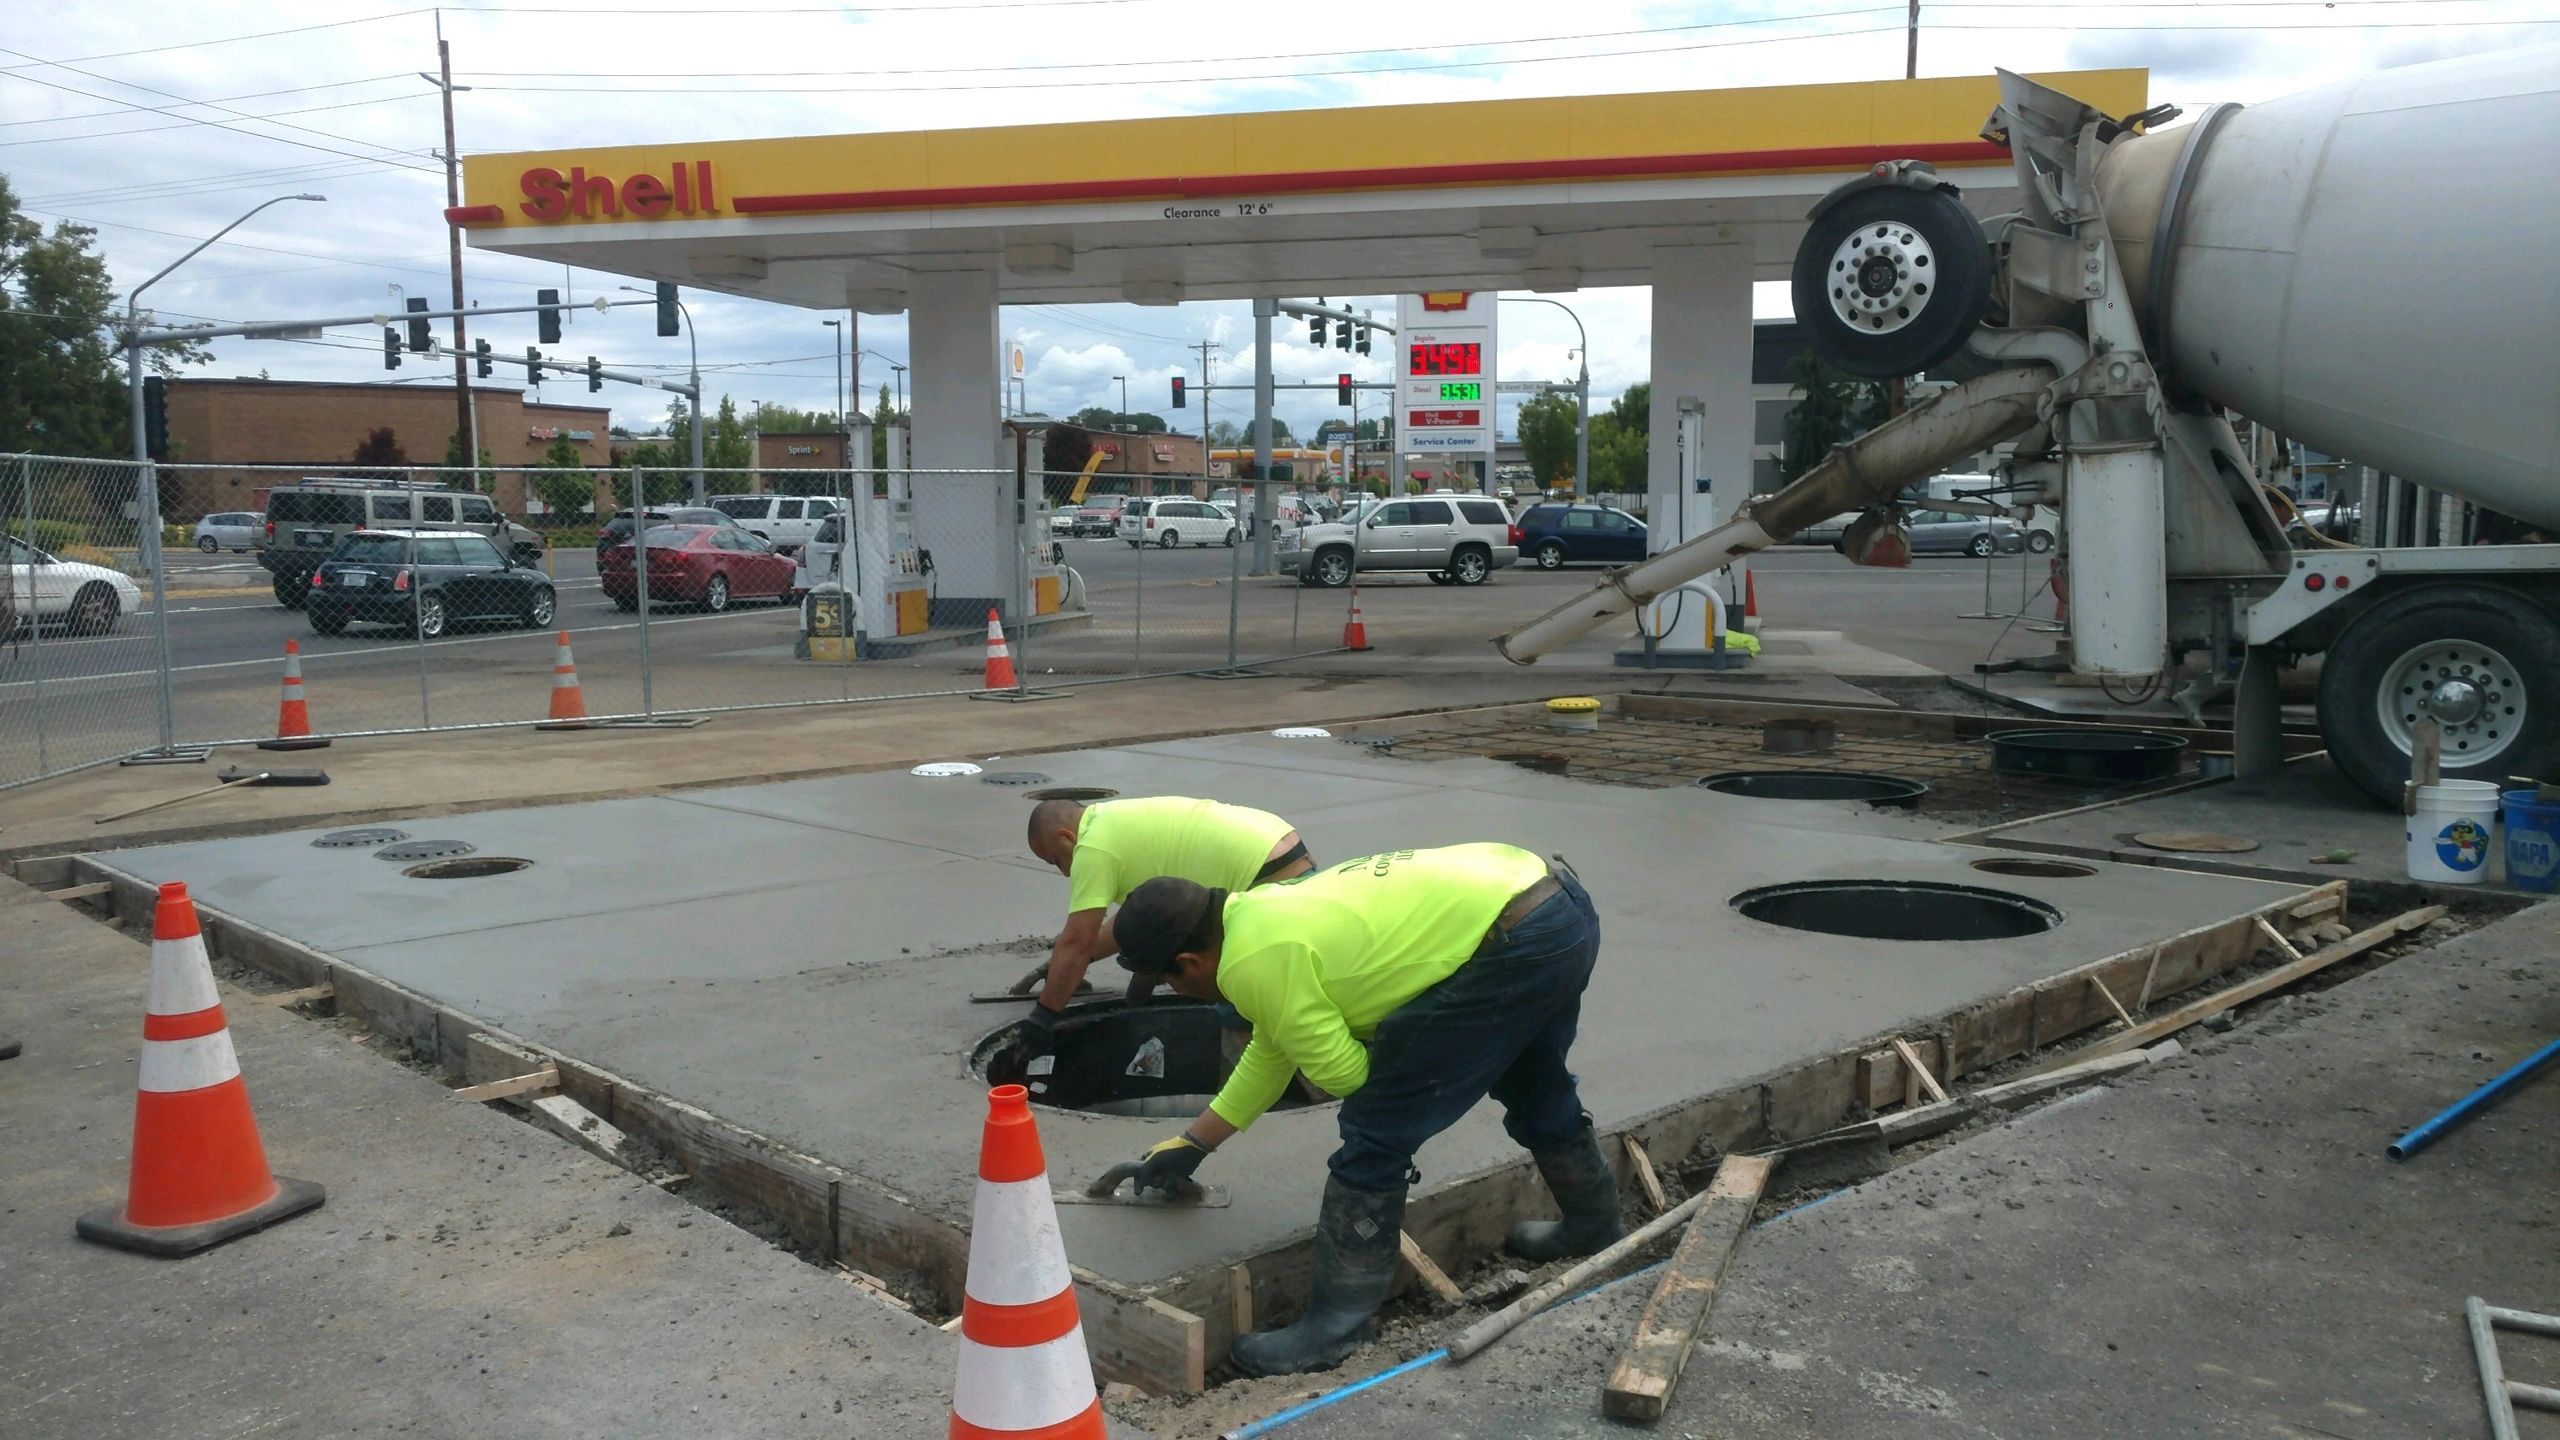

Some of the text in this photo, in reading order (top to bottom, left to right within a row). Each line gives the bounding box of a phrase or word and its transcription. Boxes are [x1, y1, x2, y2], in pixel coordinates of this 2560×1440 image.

[520, 160, 716, 221] Shell
[1163, 206, 1221, 219] Clearance
[1413, 385, 1432, 393] Diesel
[1413, 437, 1477, 446] Service Center
[788, 445, 811, 455] Sprint
